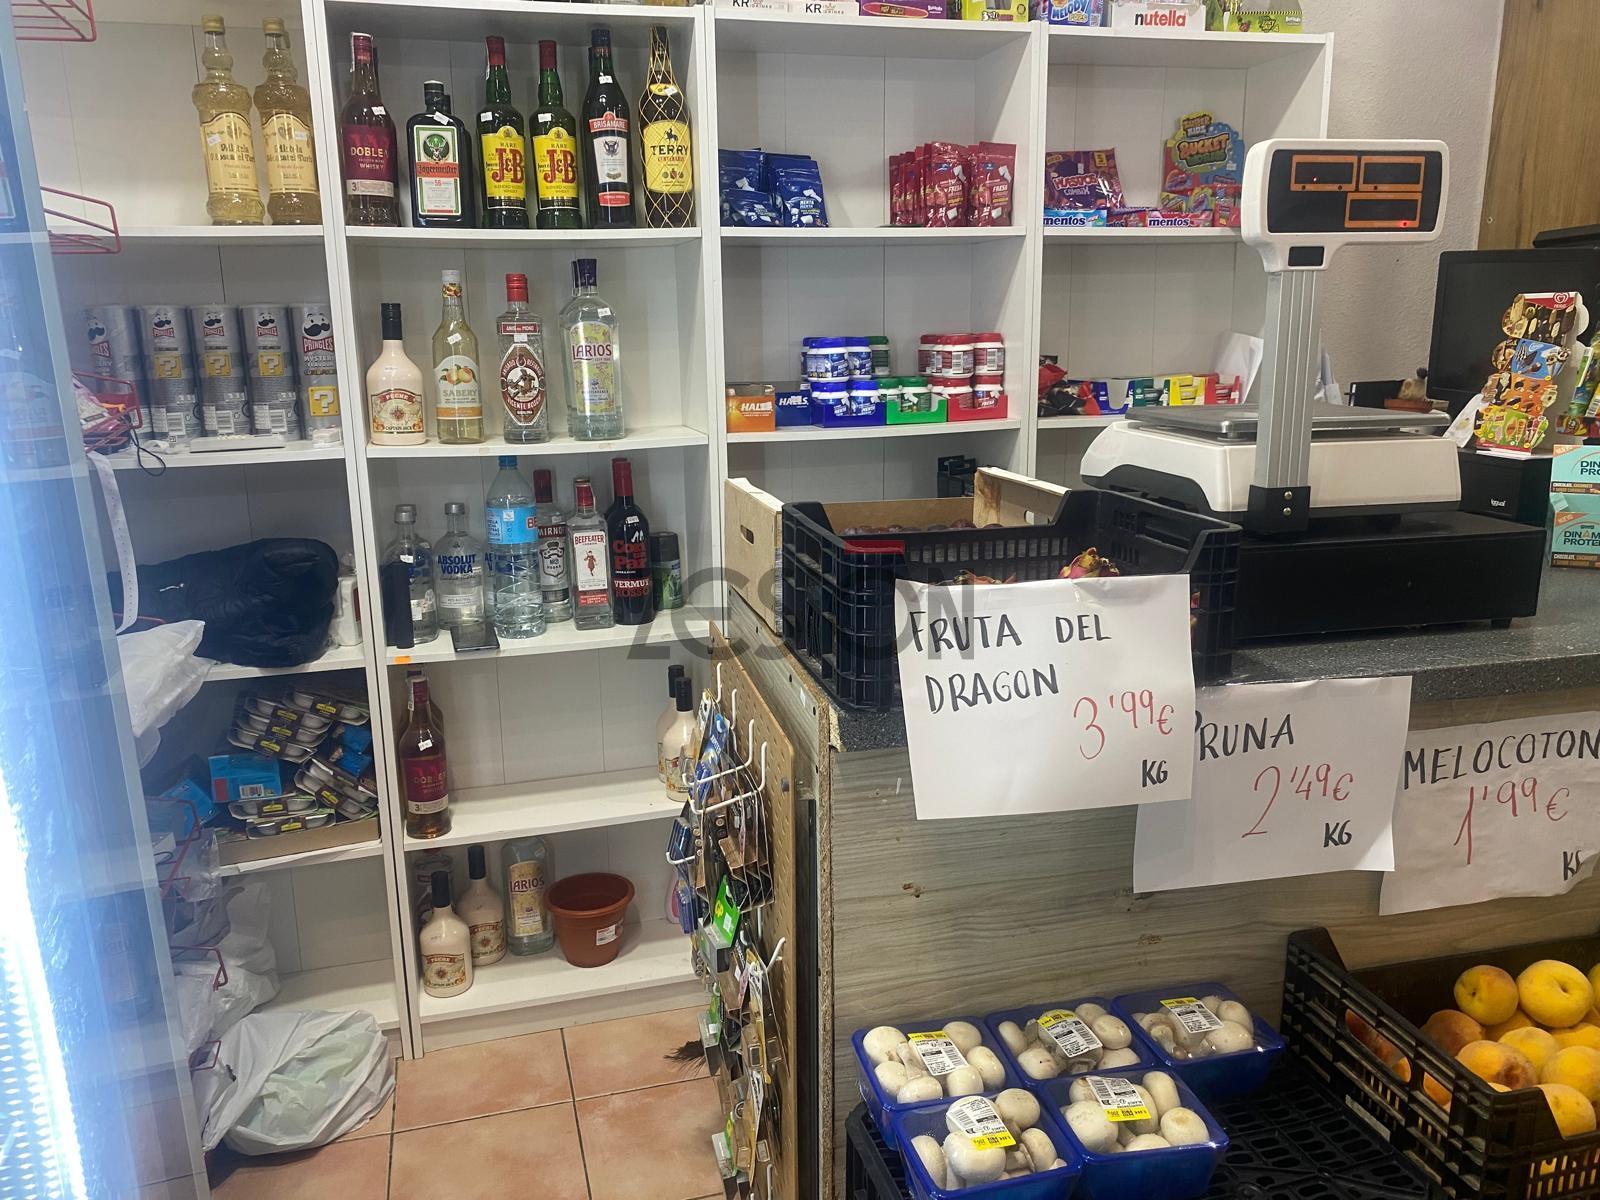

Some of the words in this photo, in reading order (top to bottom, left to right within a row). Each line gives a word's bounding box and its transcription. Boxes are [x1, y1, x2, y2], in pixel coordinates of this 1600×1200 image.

[805, 3, 822, 13] KR
[1051, 0, 1090, 19] MELODY
[1134, 10, 1187, 26] nutella
[593, 120, 627, 130] BRISAMARE
[351, 147, 384, 158] DOBLE
[650, 144, 689, 156] TERRY
[1178, 133, 1229, 160] BUCKET
[491, 147, 525, 183] J&B
[543, 149, 577, 184] J&B
[351, 182, 358, 192] 3
[1043, 215, 1086, 226] mentos
[1149, 216, 1190, 227] mentos
[203, 327, 224, 336] PRINGLES
[257, 327, 278, 336] PRINGLES
[303, 338, 334, 353] PRINGLES
[572, 343, 613, 361] LARIOS
[443, 389, 478, 398] SABERY
[574, 534, 605, 545] BEEFEATER
[437, 553, 477, 565] ABSOLUT
[441, 564, 474, 575] VODKA
[613, 579, 649, 588] VERMUT
[615, 587, 650, 598] ROSSO
[909, 611, 1023, 653] FRUTA
[1055, 614, 1112, 644] DEL
[925, 663, 1060, 715] DRAGON
[1404, 729, 1600, 790] MELOCOTON
[1141, 759, 1168, 788] KG
[414, 803, 421, 812] 3
[1323, 819, 1353, 848] KG
[510, 875, 545, 893] LARIOS
